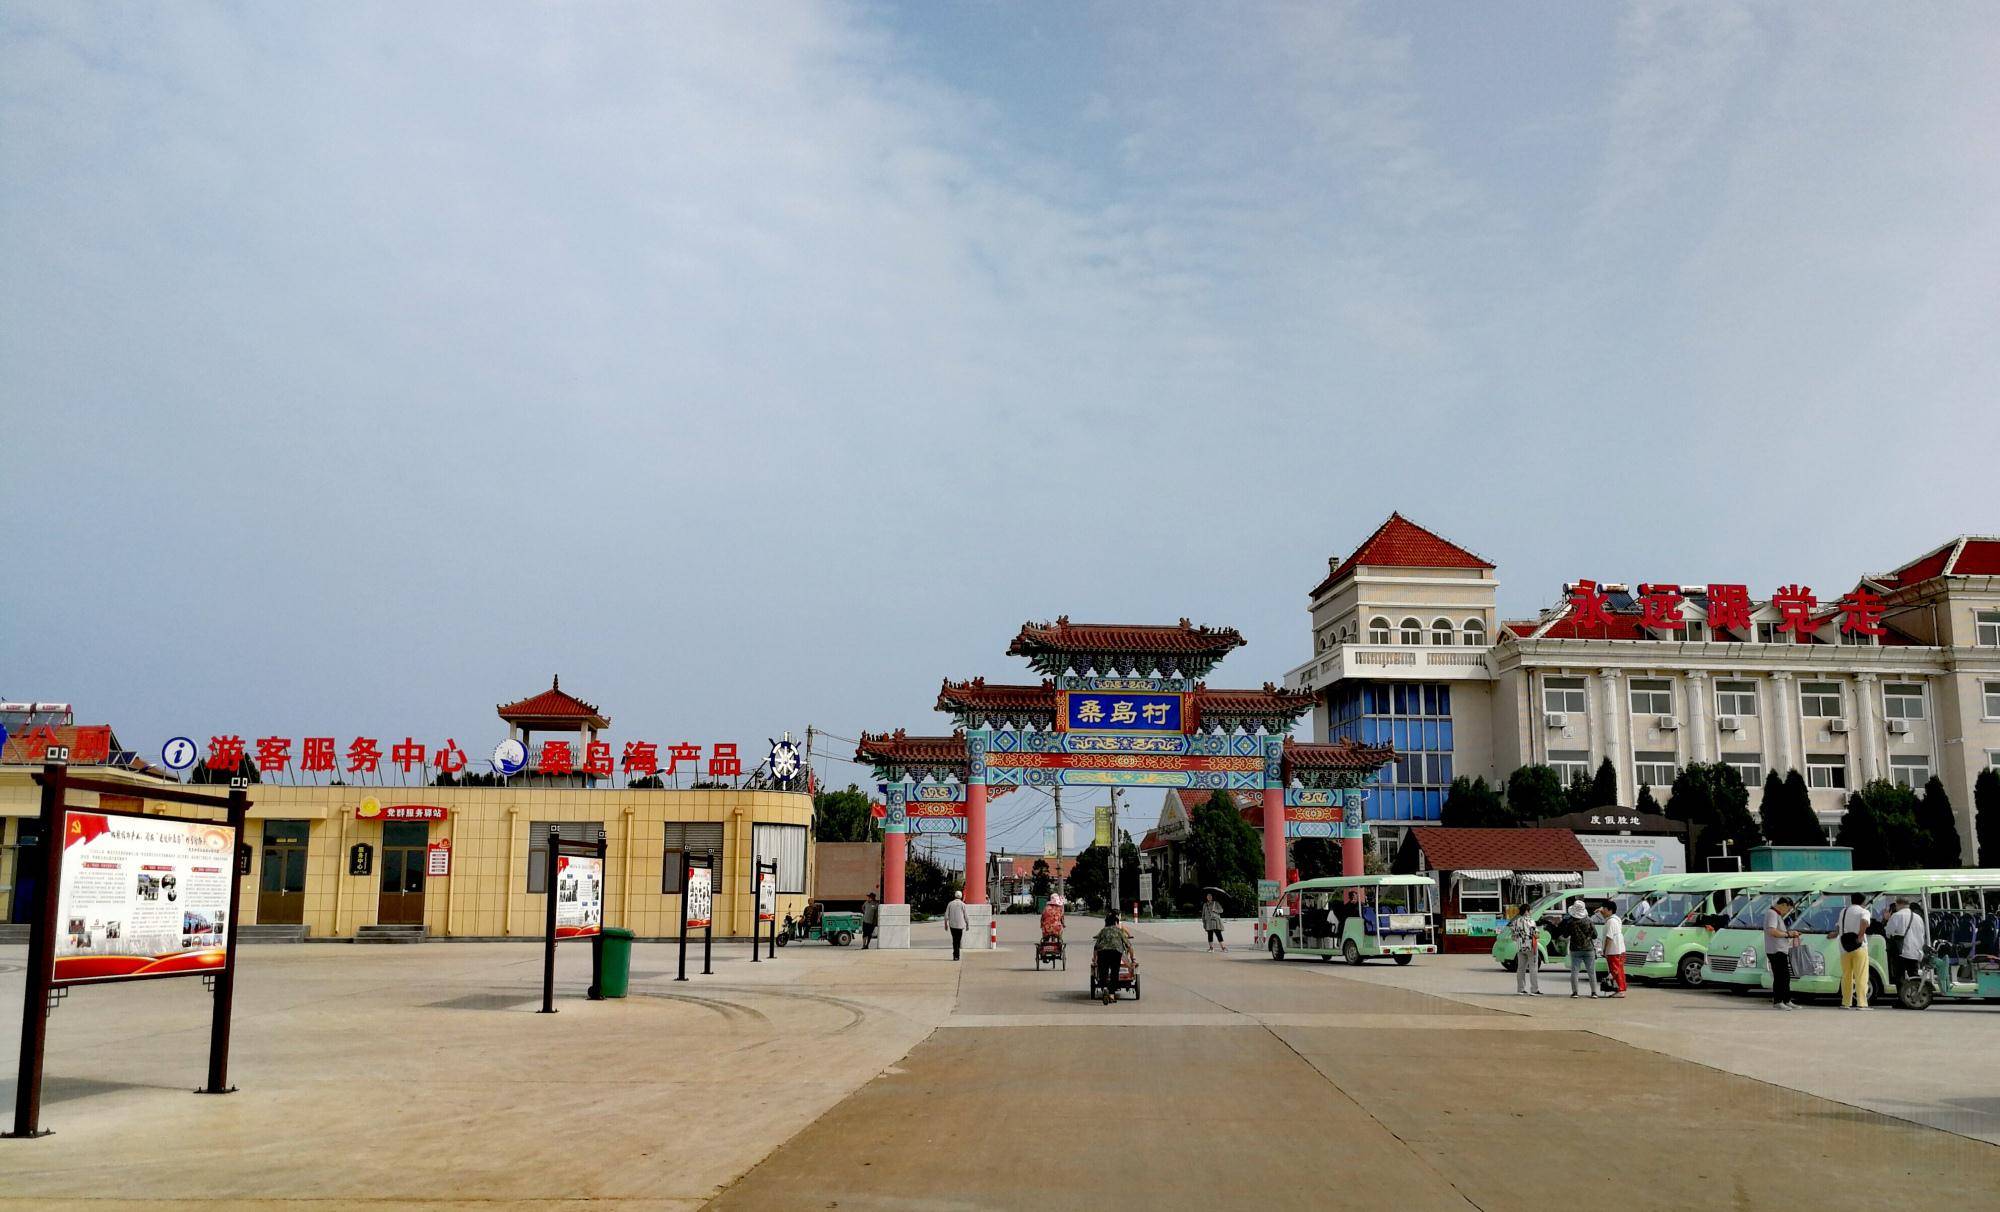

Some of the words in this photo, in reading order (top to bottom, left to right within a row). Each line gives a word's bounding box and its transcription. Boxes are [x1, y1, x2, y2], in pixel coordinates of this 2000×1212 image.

[1569, 579, 1888, 635] 永远跟党走
[205, 735, 468, 773] 游客服务中心
[538, 740, 741, 777] 桑岛海产品
[1590, 815, 1641, 825] 度假胜地
